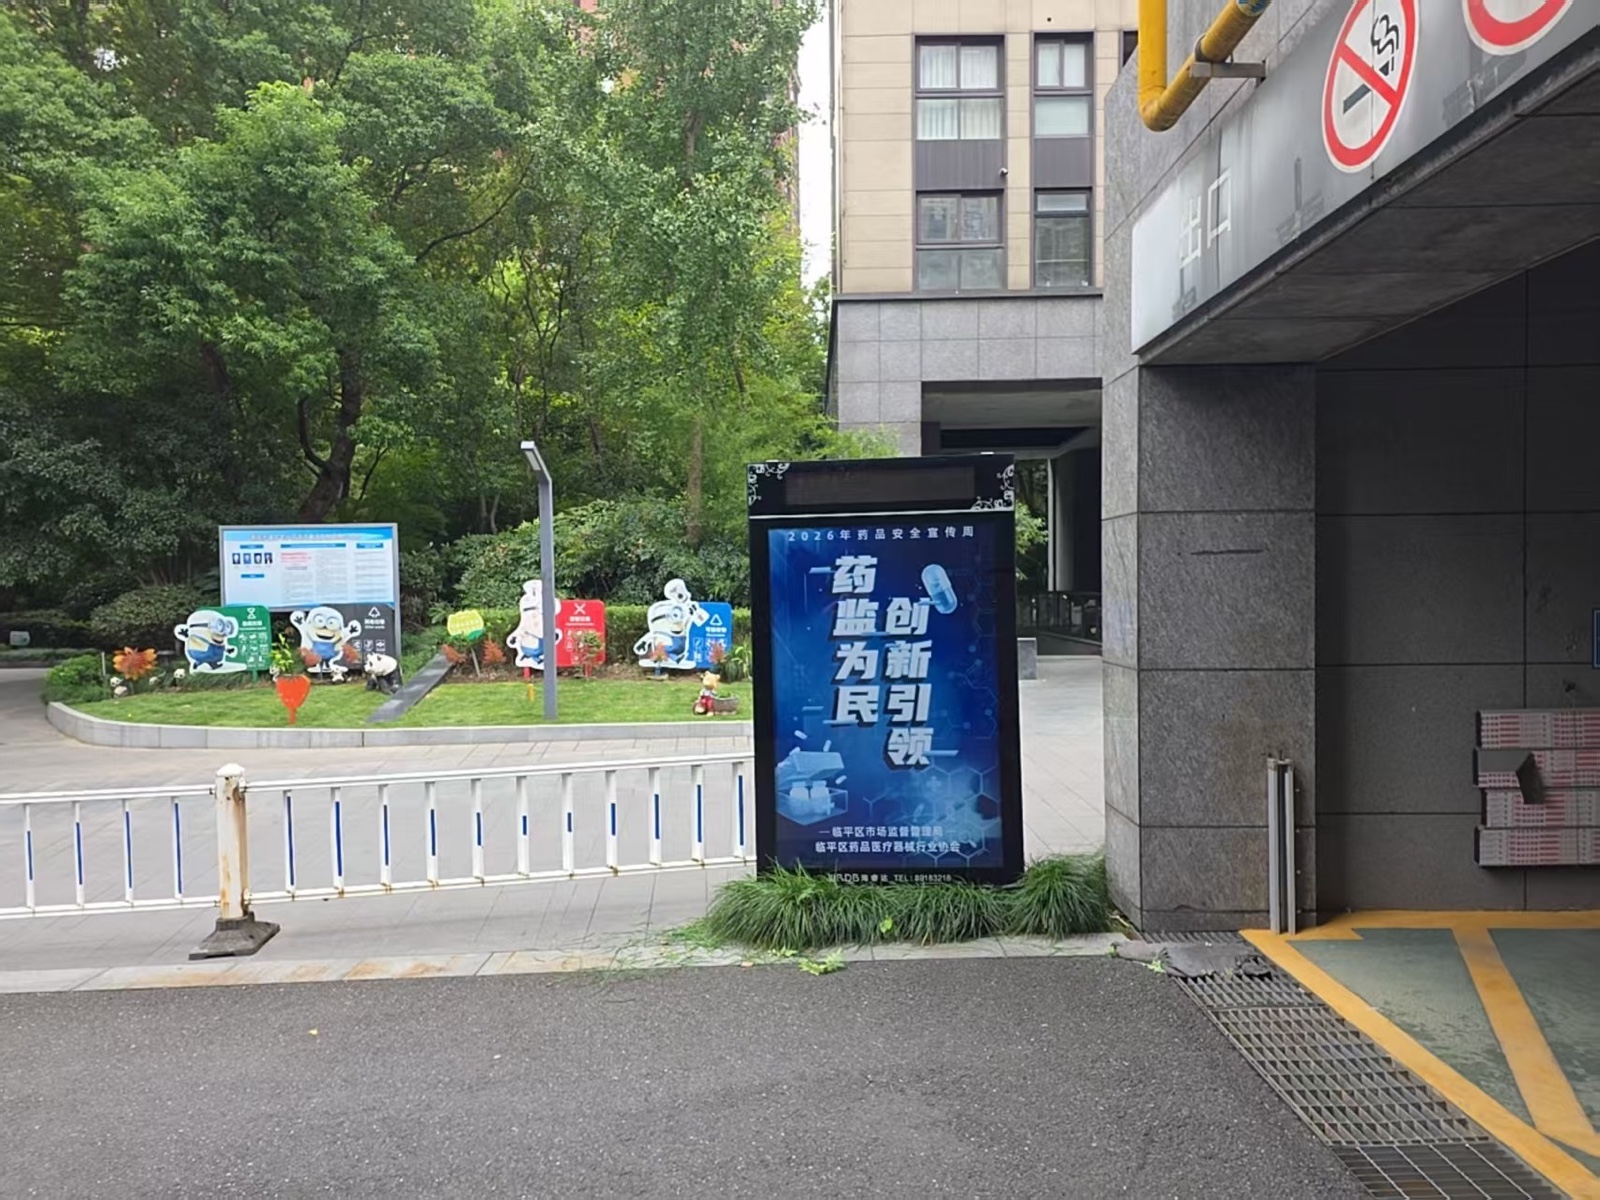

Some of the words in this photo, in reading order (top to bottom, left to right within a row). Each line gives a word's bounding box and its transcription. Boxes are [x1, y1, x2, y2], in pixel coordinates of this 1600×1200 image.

[1180, 169, 1231, 269] 出口
[788, 526, 975, 542] 2026年药品安全宣传周
[832, 555, 879, 723] 药监为民
[885, 597, 934, 766] 创新引领
[815, 841, 961, 853] 临平区药品医疗器械行业协会
[832, 826, 944, 838] 临平区市场监督管理局
